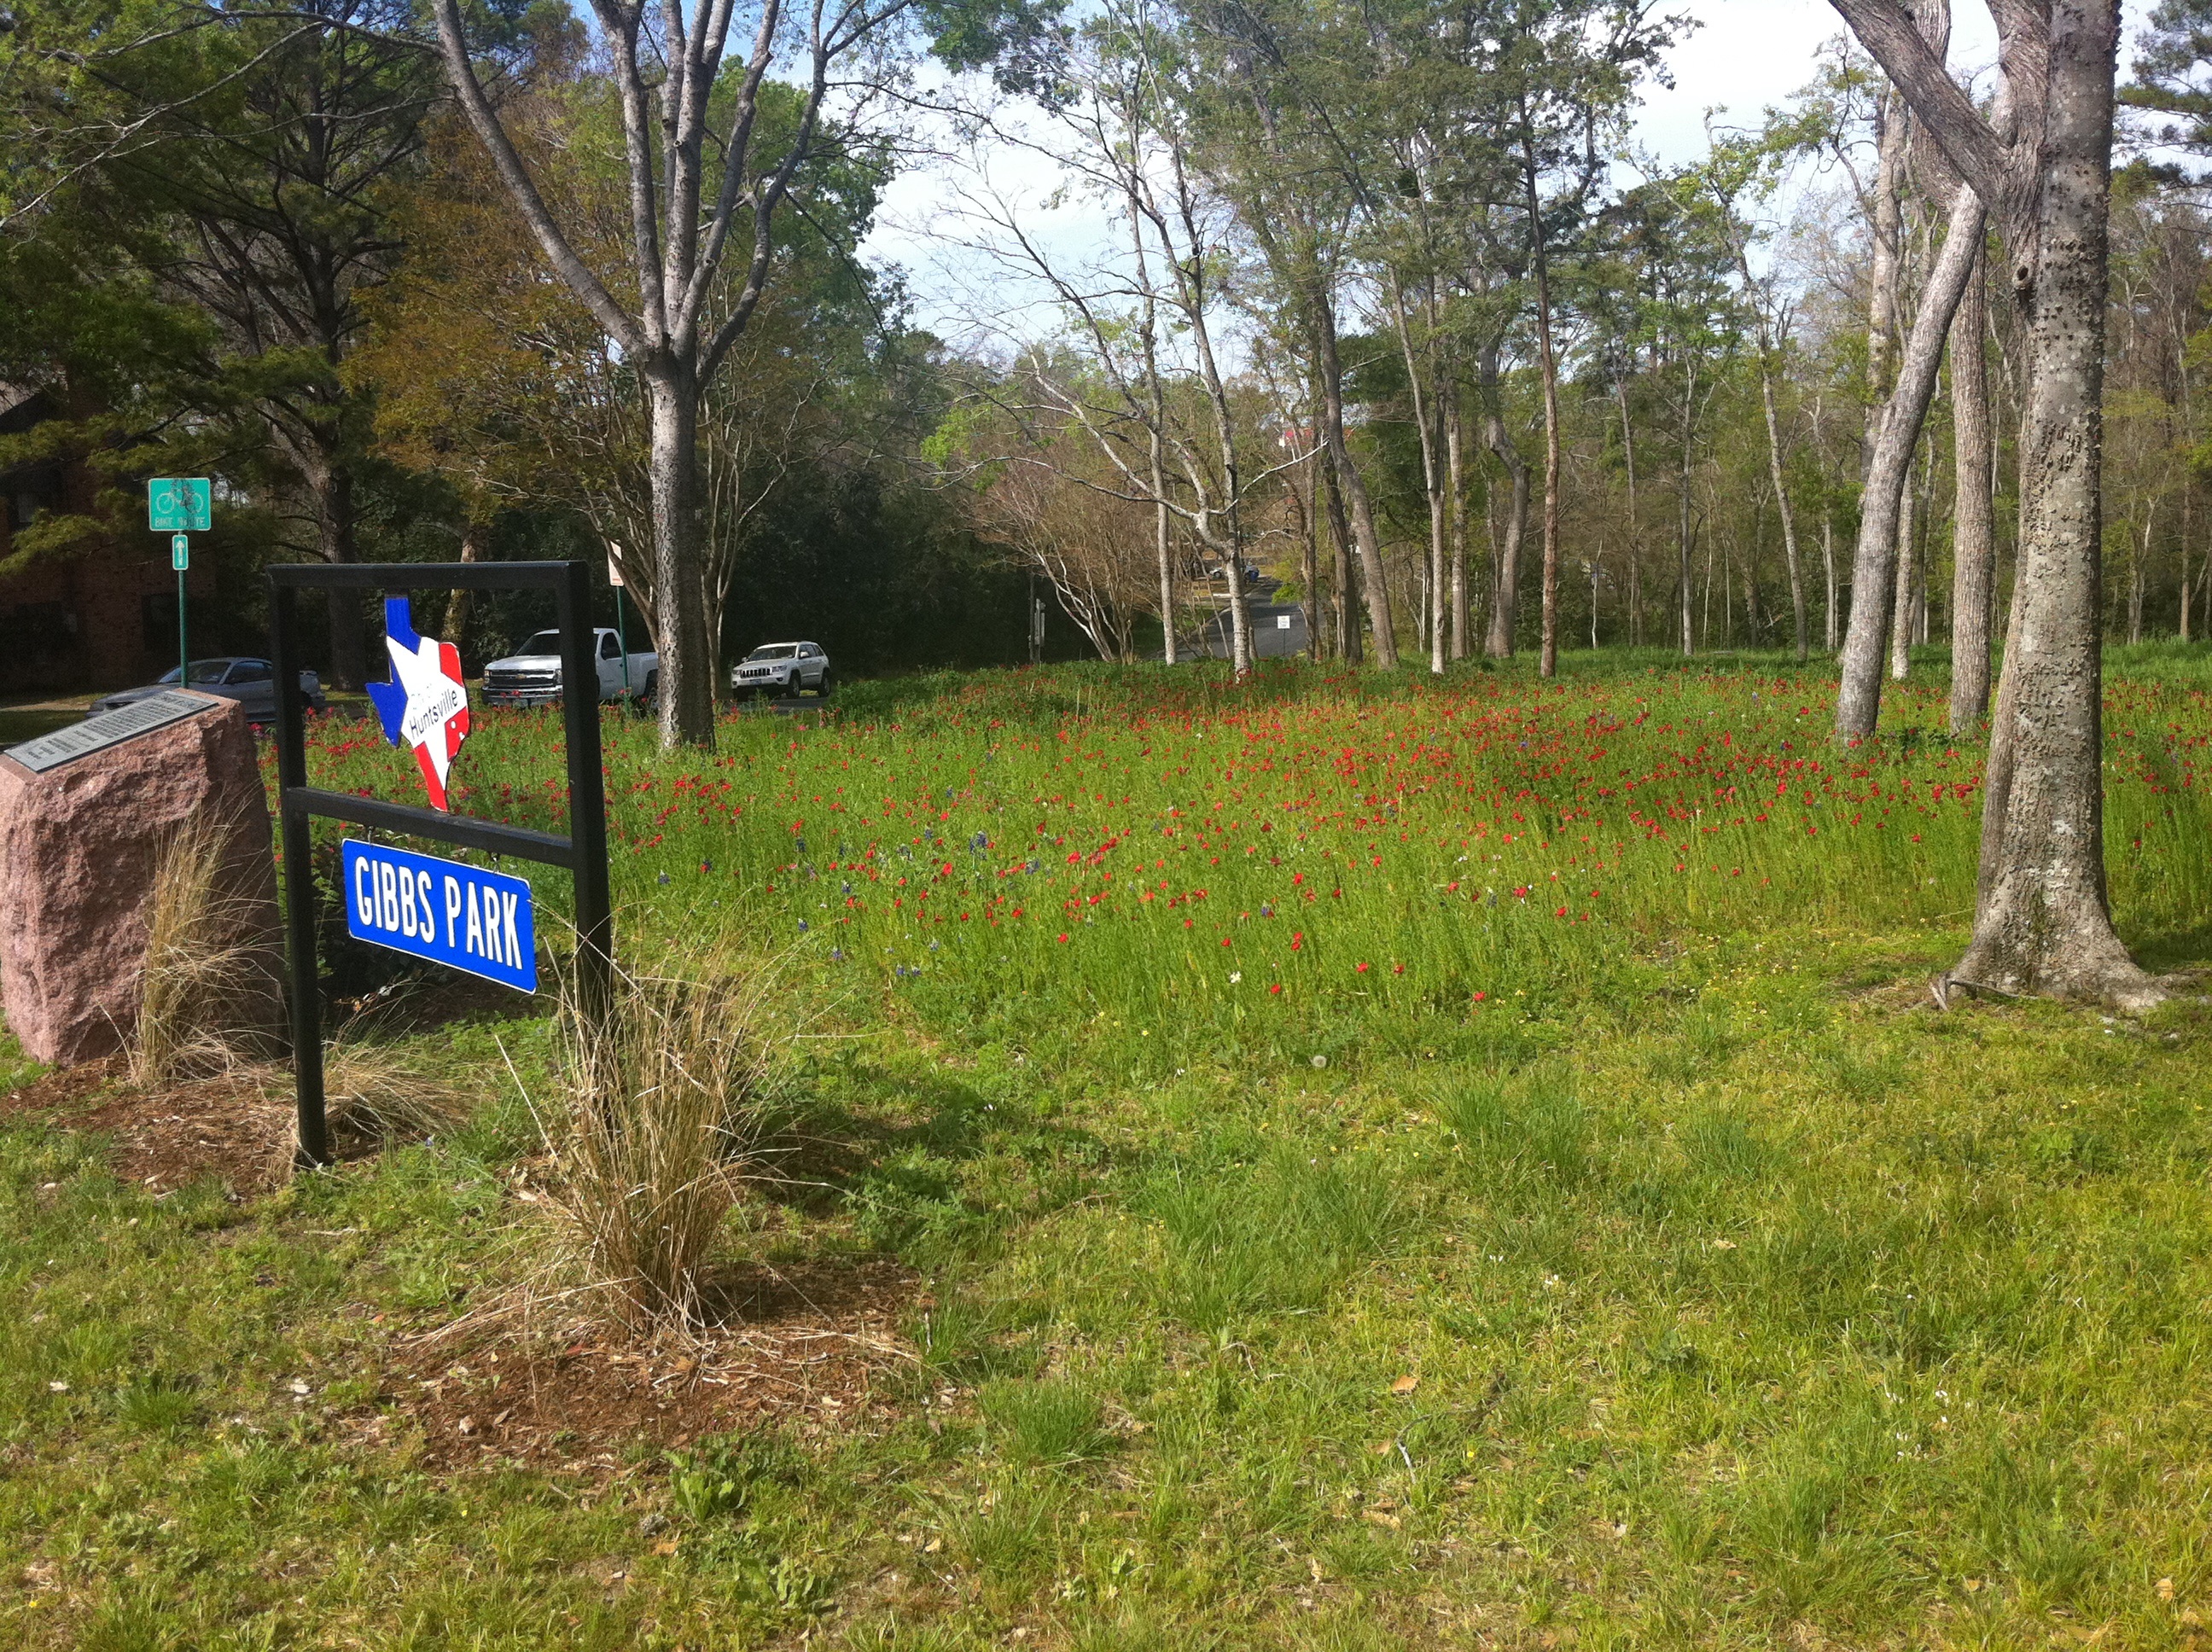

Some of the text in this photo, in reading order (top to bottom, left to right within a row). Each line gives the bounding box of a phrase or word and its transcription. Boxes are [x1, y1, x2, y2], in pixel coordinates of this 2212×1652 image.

[409, 689, 458, 740] Huntsville
[355, 856, 523, 970] GIBBS PARK
